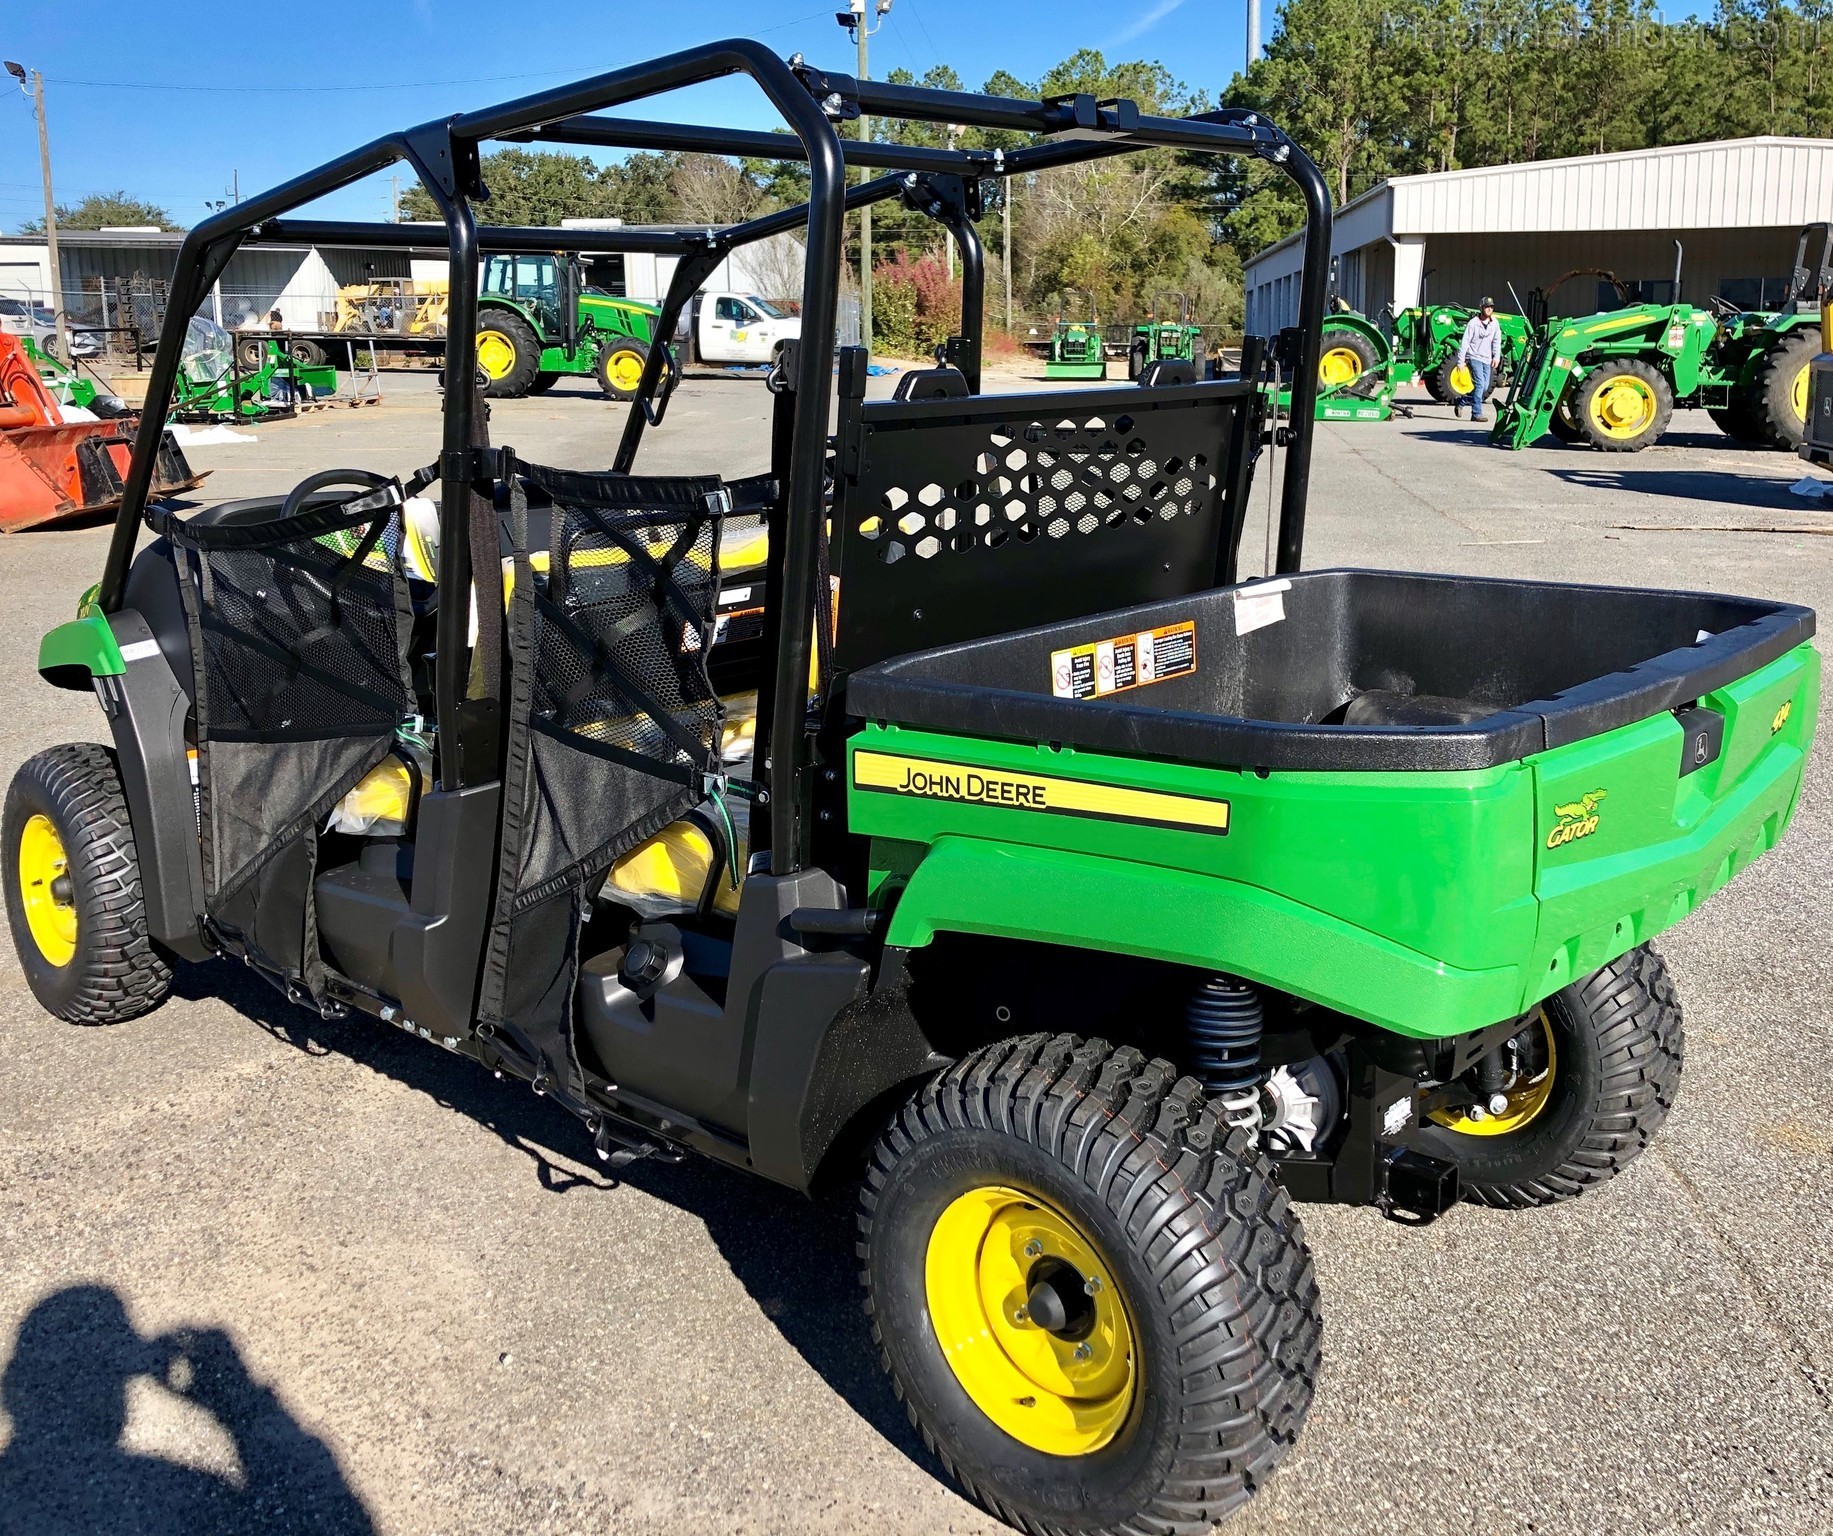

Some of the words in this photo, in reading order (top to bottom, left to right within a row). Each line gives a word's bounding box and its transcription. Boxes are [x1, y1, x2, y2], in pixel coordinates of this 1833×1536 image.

[899, 767, 961, 796] JOHN
[967, 774, 1046, 806] DEERE
[1546, 815, 1600, 850] GATOR
